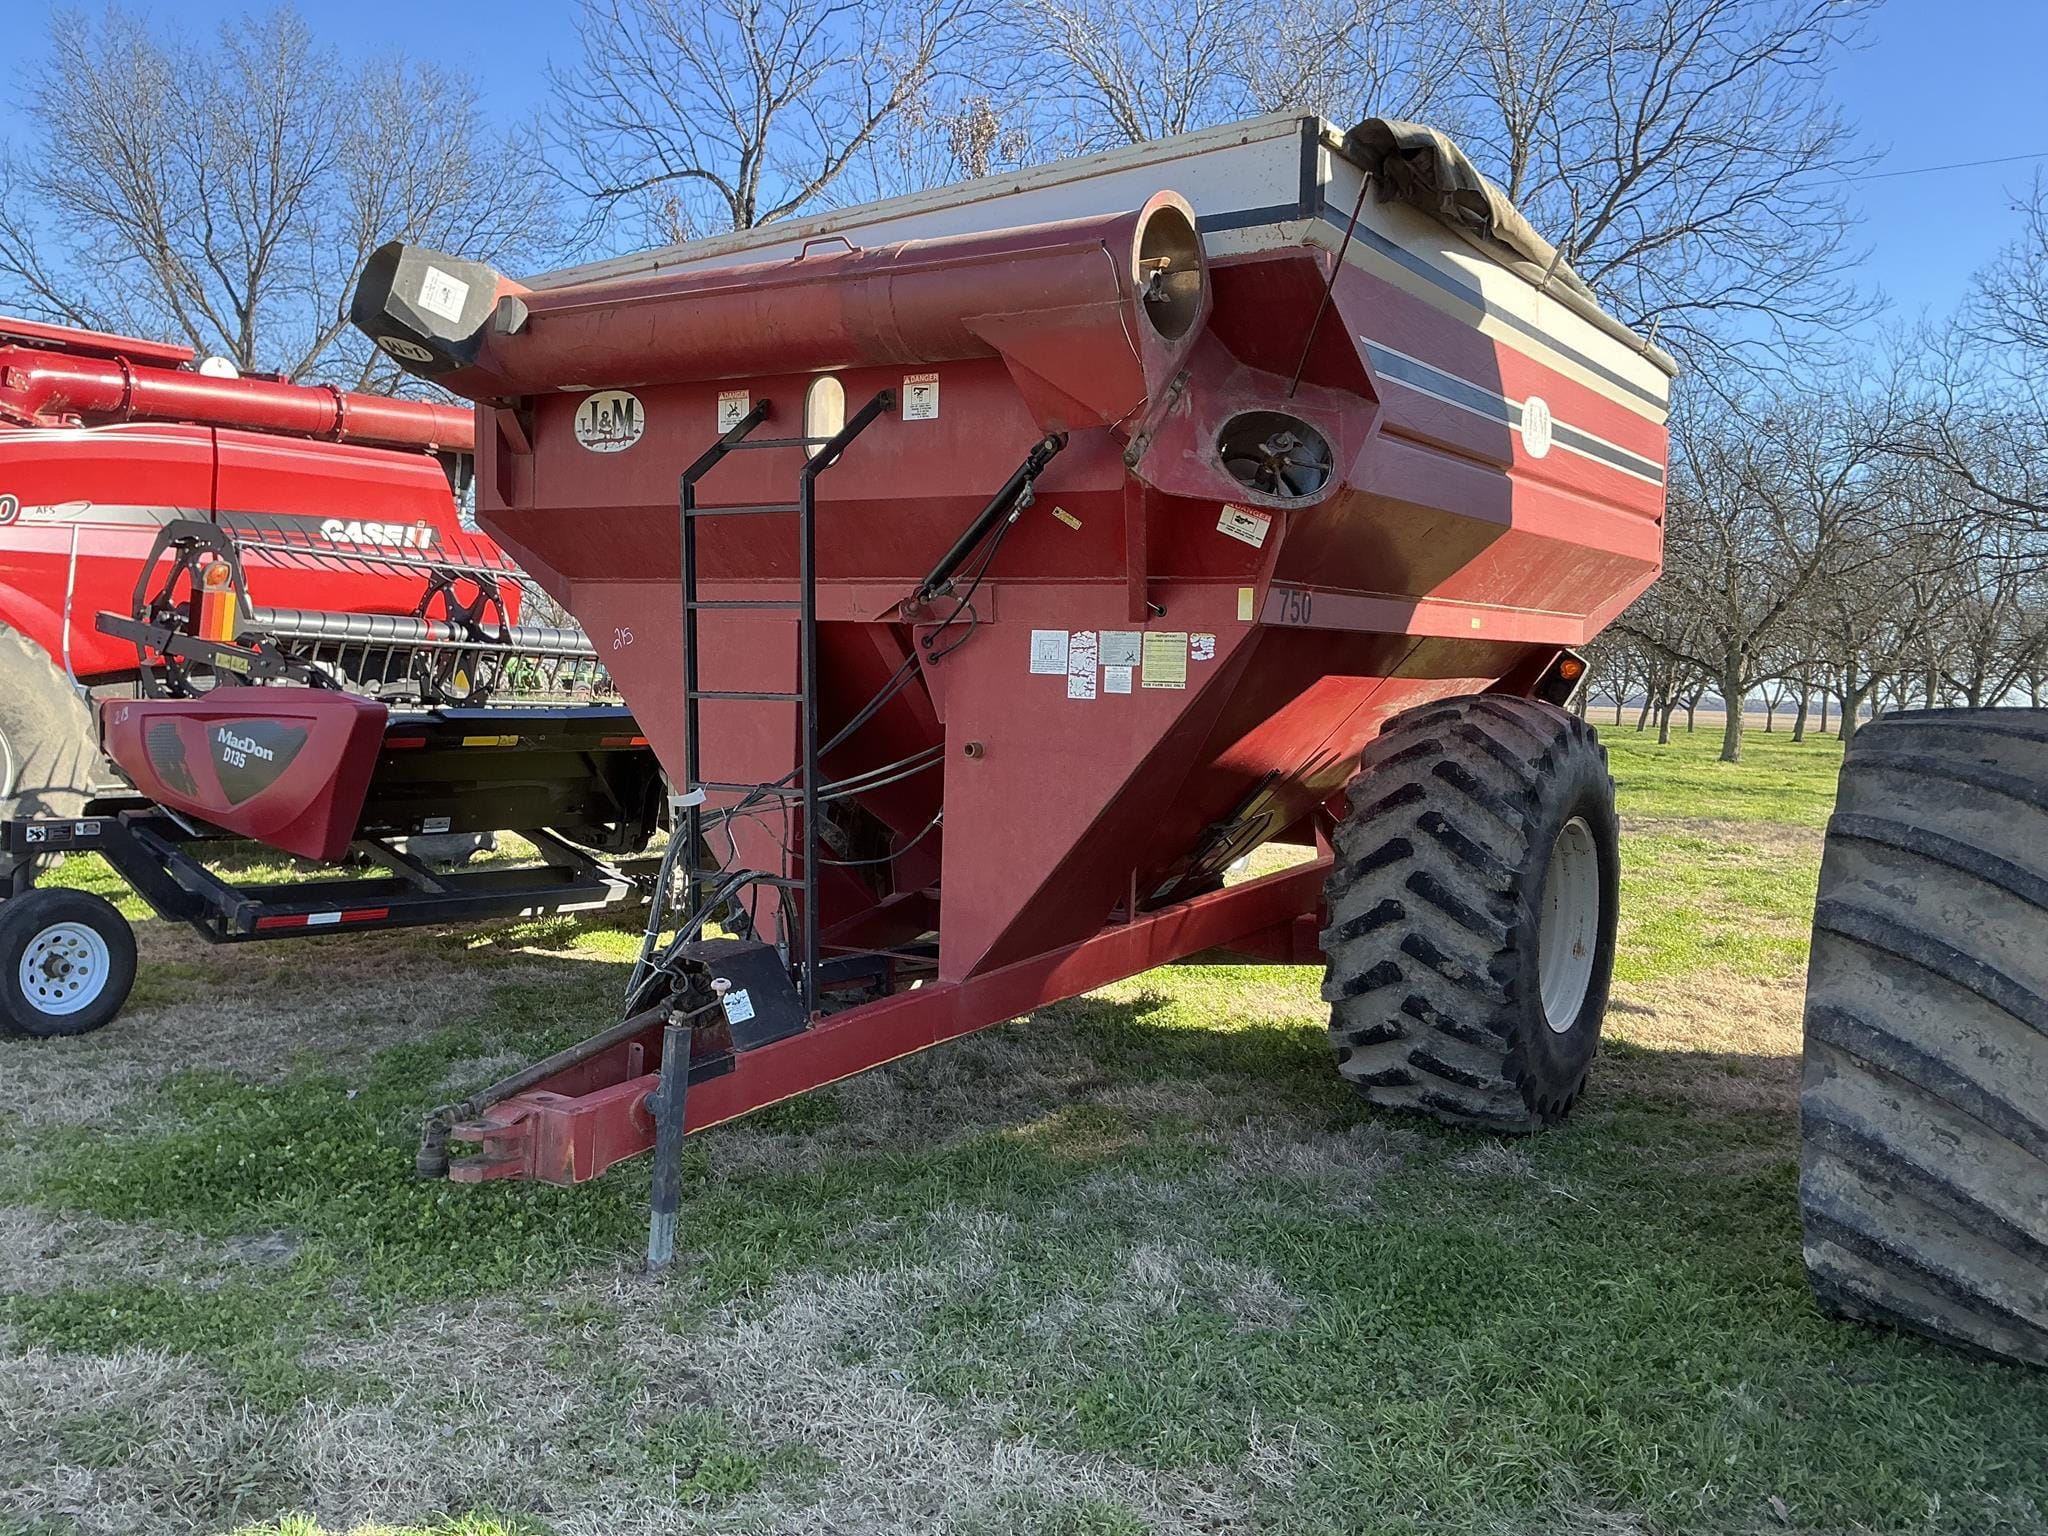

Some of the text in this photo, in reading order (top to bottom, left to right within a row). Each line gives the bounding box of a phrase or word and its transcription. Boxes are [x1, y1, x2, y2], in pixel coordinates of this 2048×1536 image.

[911, 374, 938, 384] DANGER
[589, 398, 635, 439] J&M
[36, 506, 56, 515] AFS
[1280, 590, 1312, 624] 750
[218, 728, 274, 761] MacDon
[223, 747, 247, 769] D135
